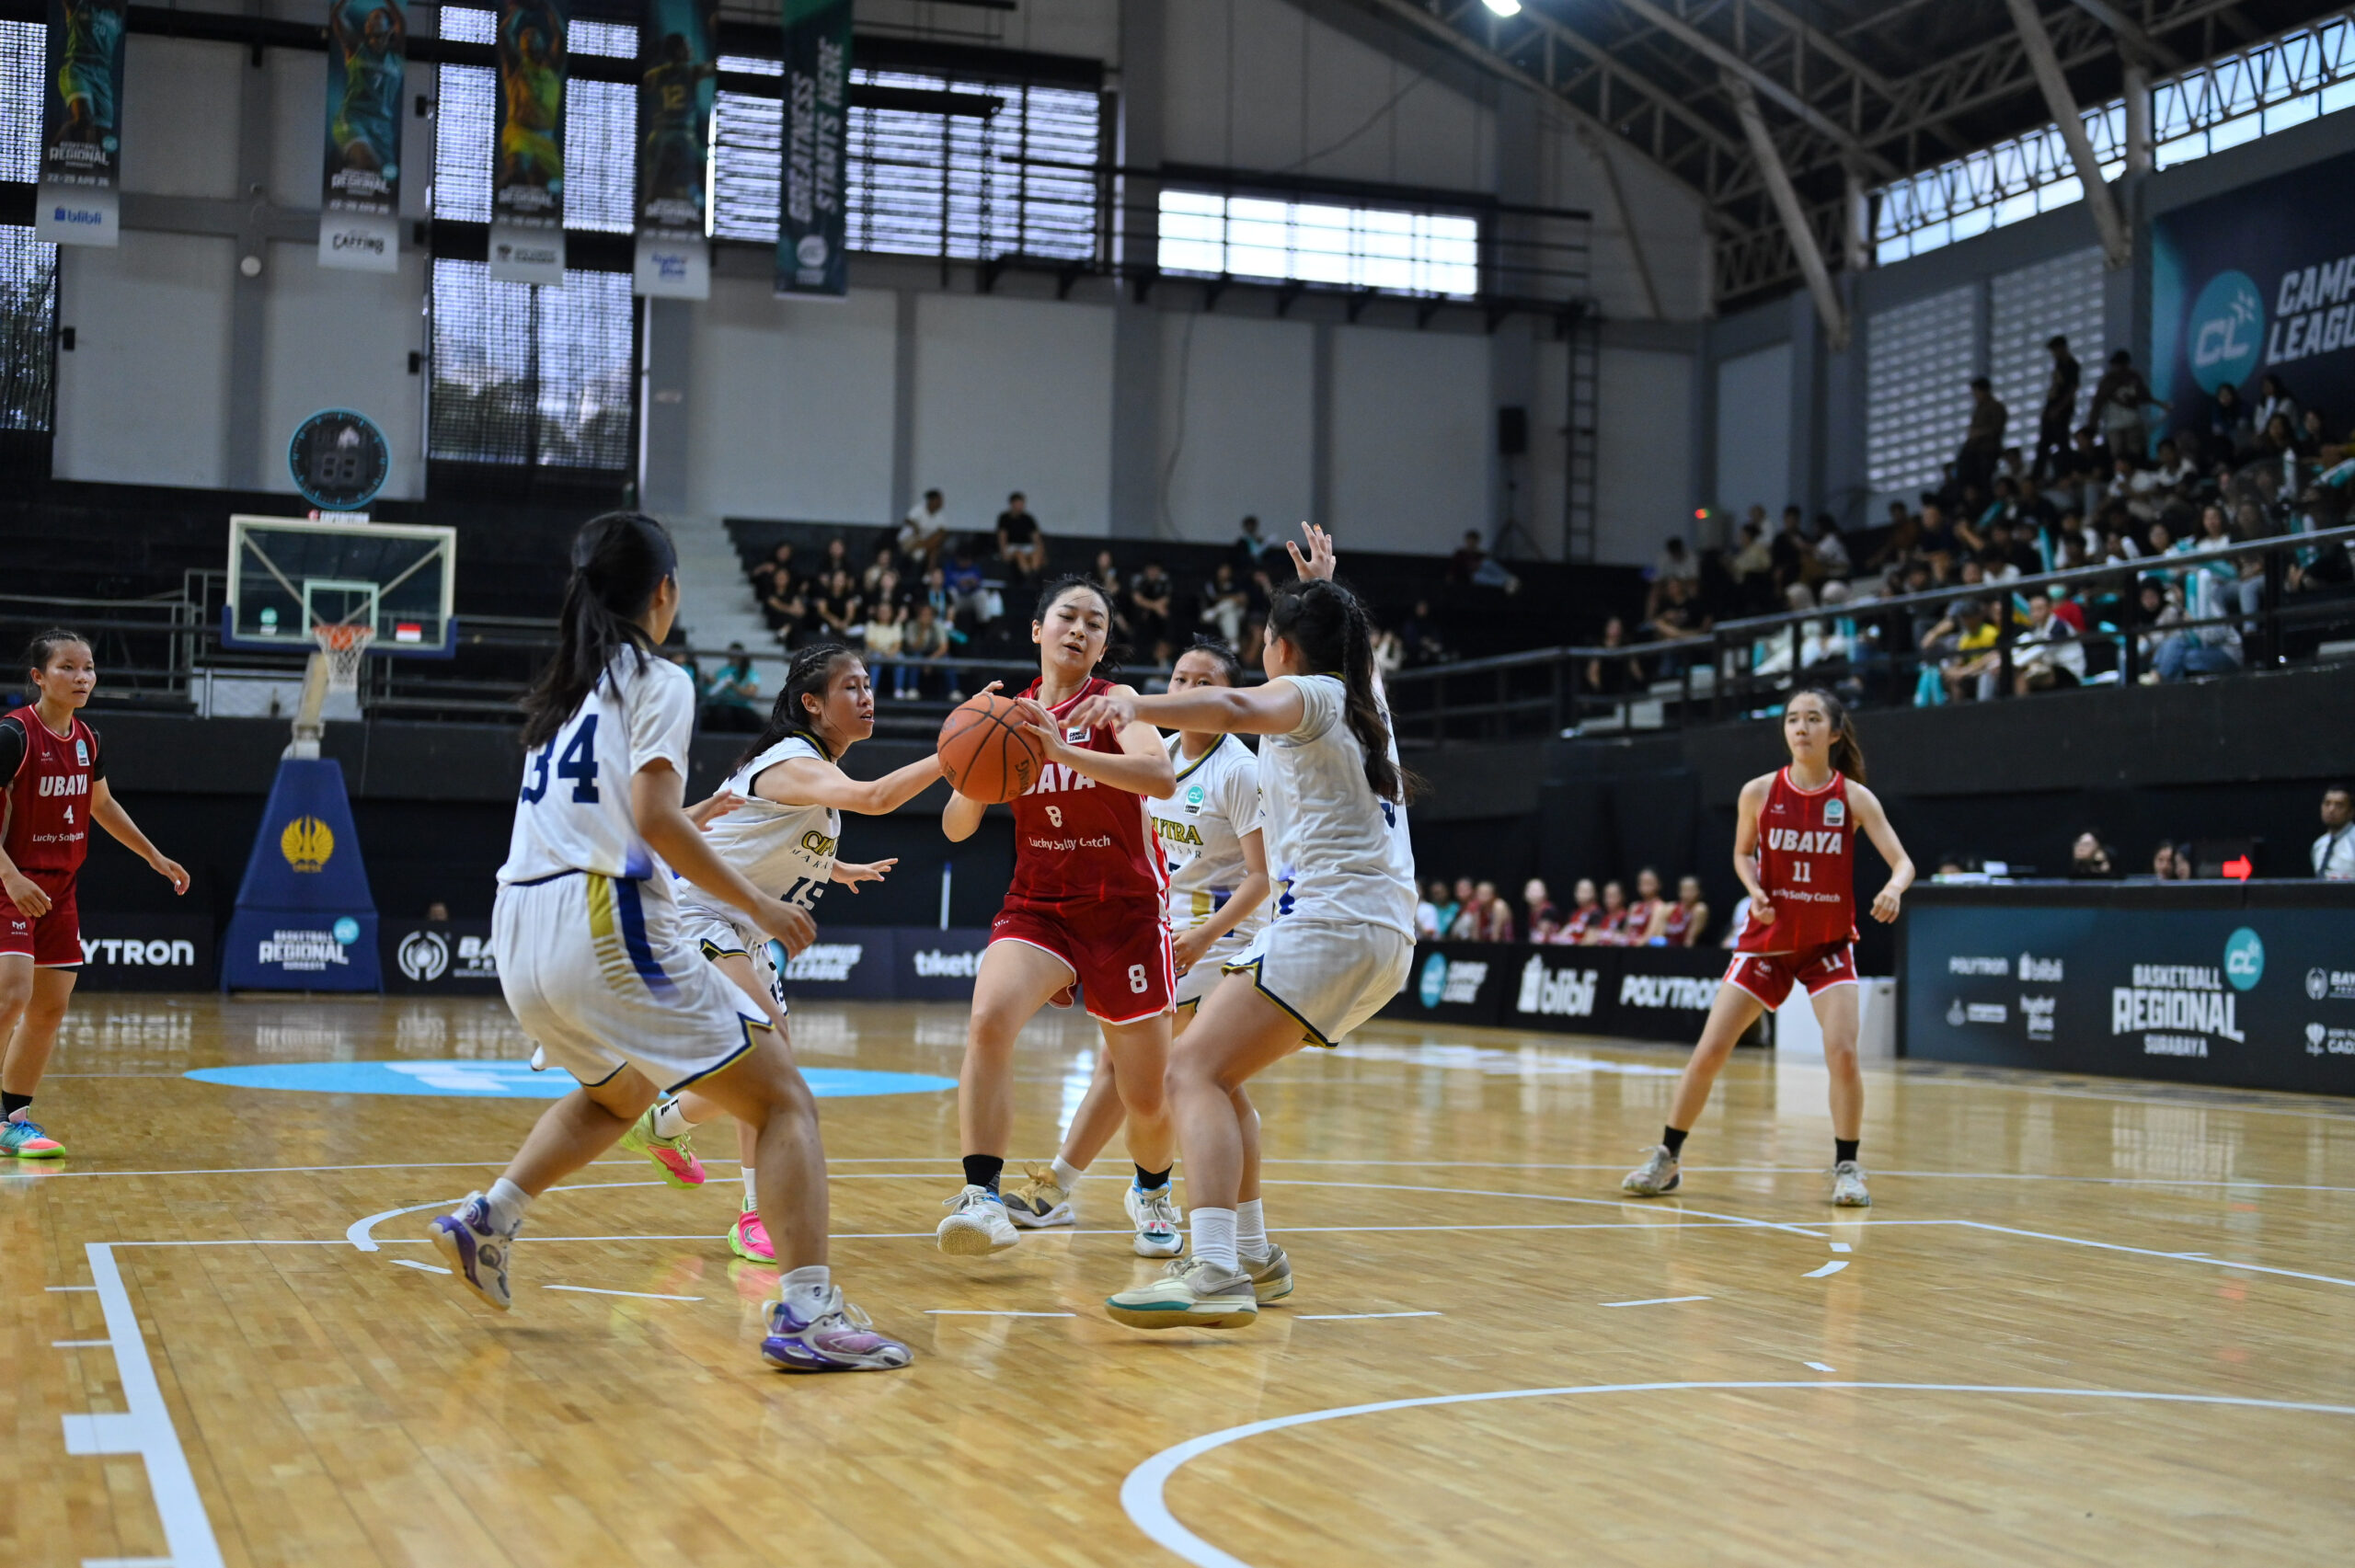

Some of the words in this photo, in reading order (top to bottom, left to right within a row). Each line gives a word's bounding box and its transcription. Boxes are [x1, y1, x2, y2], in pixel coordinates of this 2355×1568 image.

[817, 36, 844, 109] HERE
[788, 71, 815, 223] GREATNESS
[815, 111, 841, 214] STARTS
[522, 714, 600, 805] 34
[39, 774, 87, 797] UBAYA
[63, 805, 75, 825] 4
[1045, 805, 1063, 828] 8
[32, 833, 58, 844] Lucky
[1028, 837, 1053, 851] Lucky
[1079, 835, 1111, 849] Catch
[1768, 828, 1843, 855] UBAYA
[1792, 861, 1811, 883] 11
[1814, 892, 1841, 903] Catch
[258, 940, 350, 966] REGIONAL
[1821, 954, 1845, 973] 11
[1128, 964, 1149, 994] 8
[2132, 964, 2223, 990] BASKETBALL
[2112, 986, 2246, 1044] REGIONAL
[2143, 1033, 2209, 1059] SURABAYA
